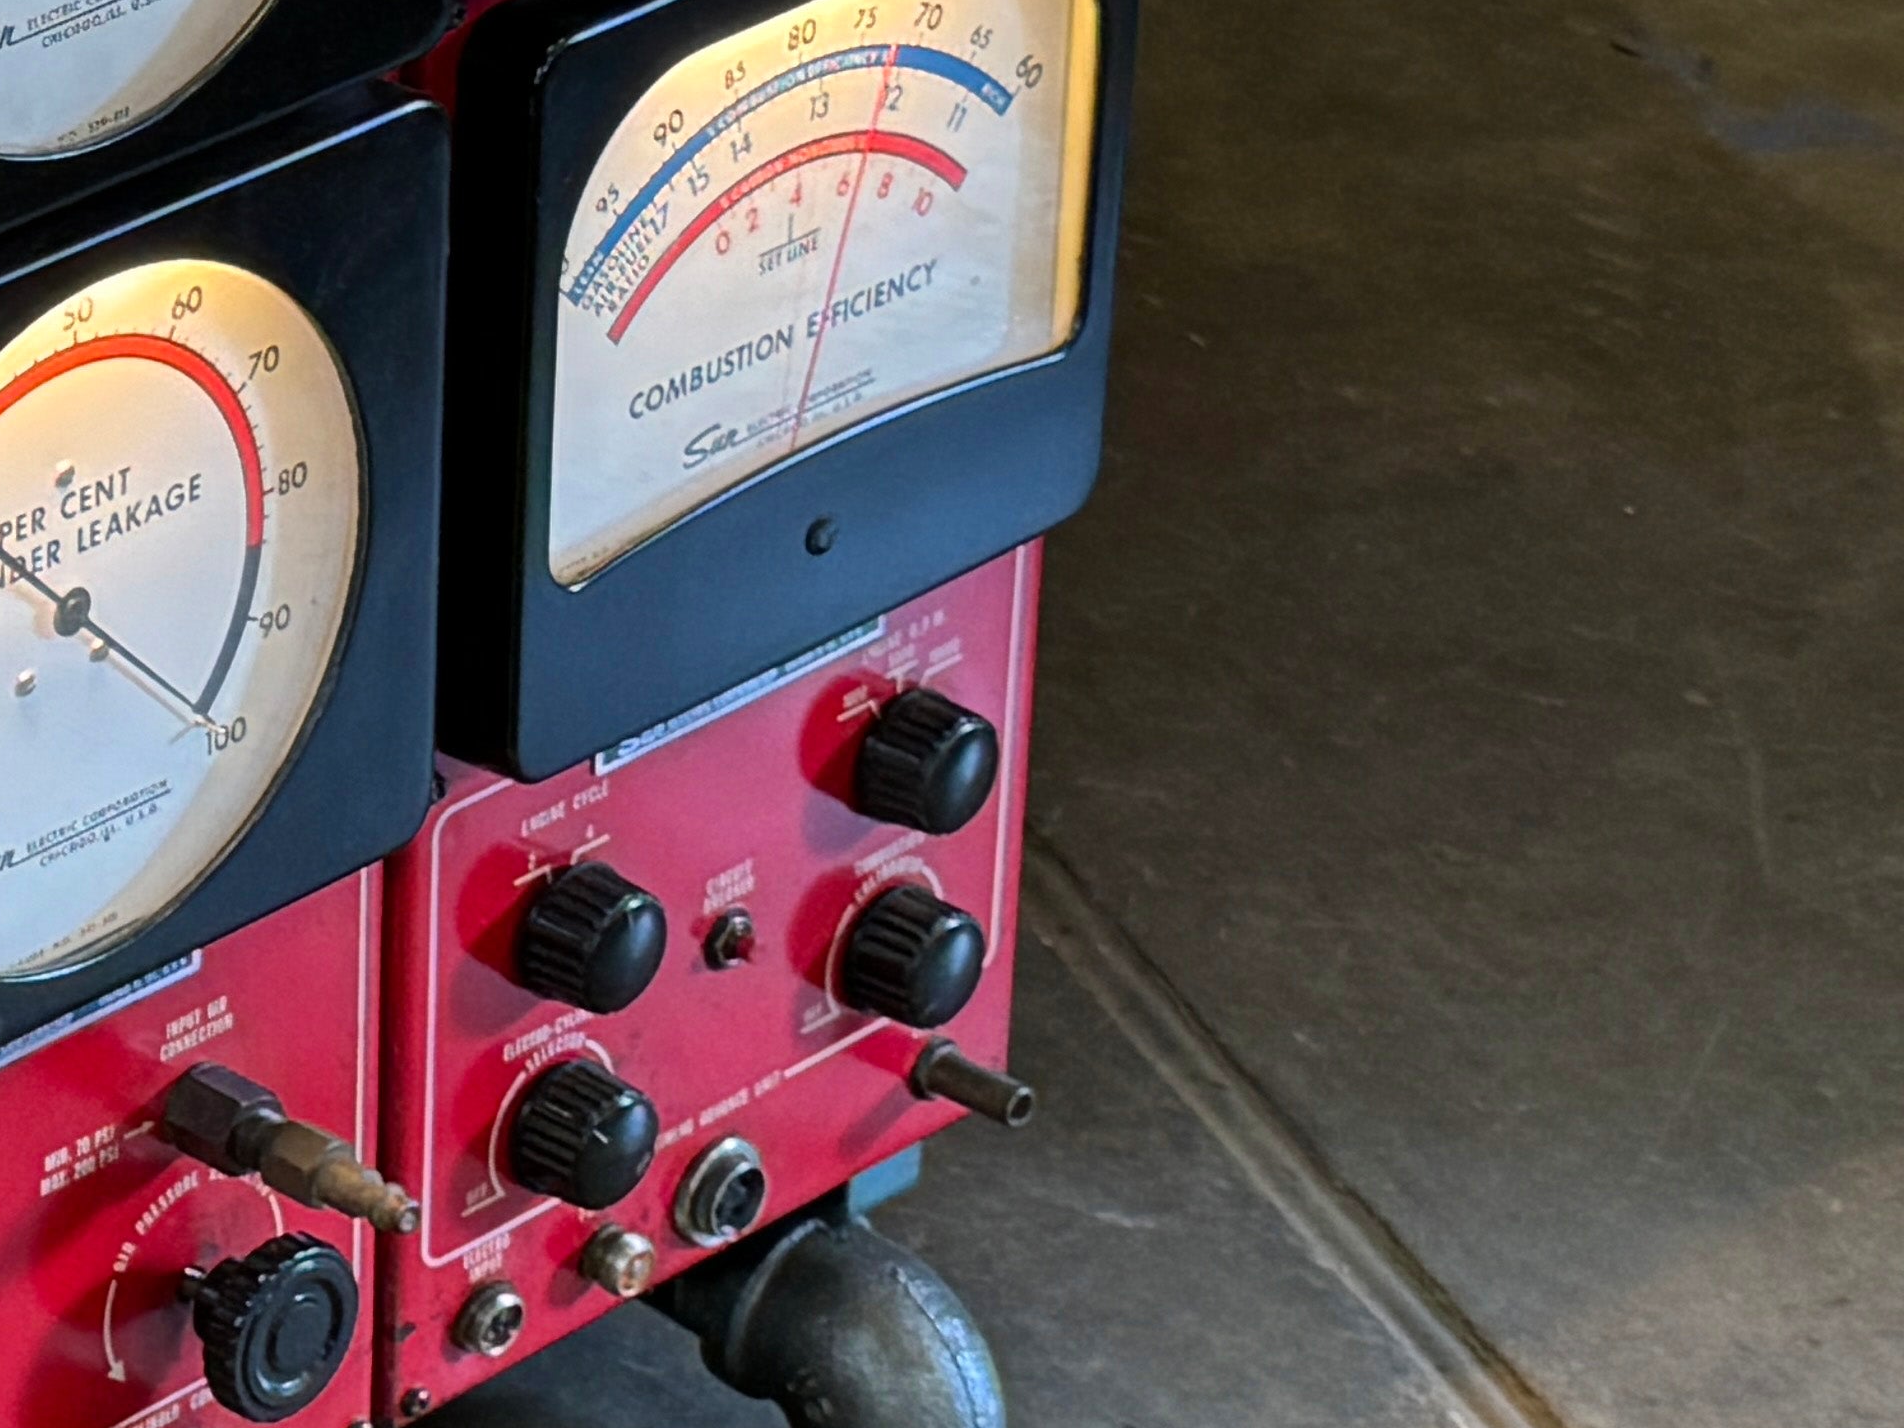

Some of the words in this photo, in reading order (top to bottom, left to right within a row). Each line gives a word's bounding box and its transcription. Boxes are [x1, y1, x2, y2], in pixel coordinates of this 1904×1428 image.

[653, 108, 683, 147] 90
[787, 19, 817, 51] 80
[914, 2, 943, 31] 70
[171, 285, 204, 321] 60
[629, 324, 794, 420] COMBUSTION
[806, 259, 938, 338] EFFICIENCY
[247, 344, 279, 381] 70
[60, 467, 131, 521] CENT
[277, 461, 308, 496] 80
[76, 472, 203, 554] LEAKAGE
[258, 603, 291, 638] 90
